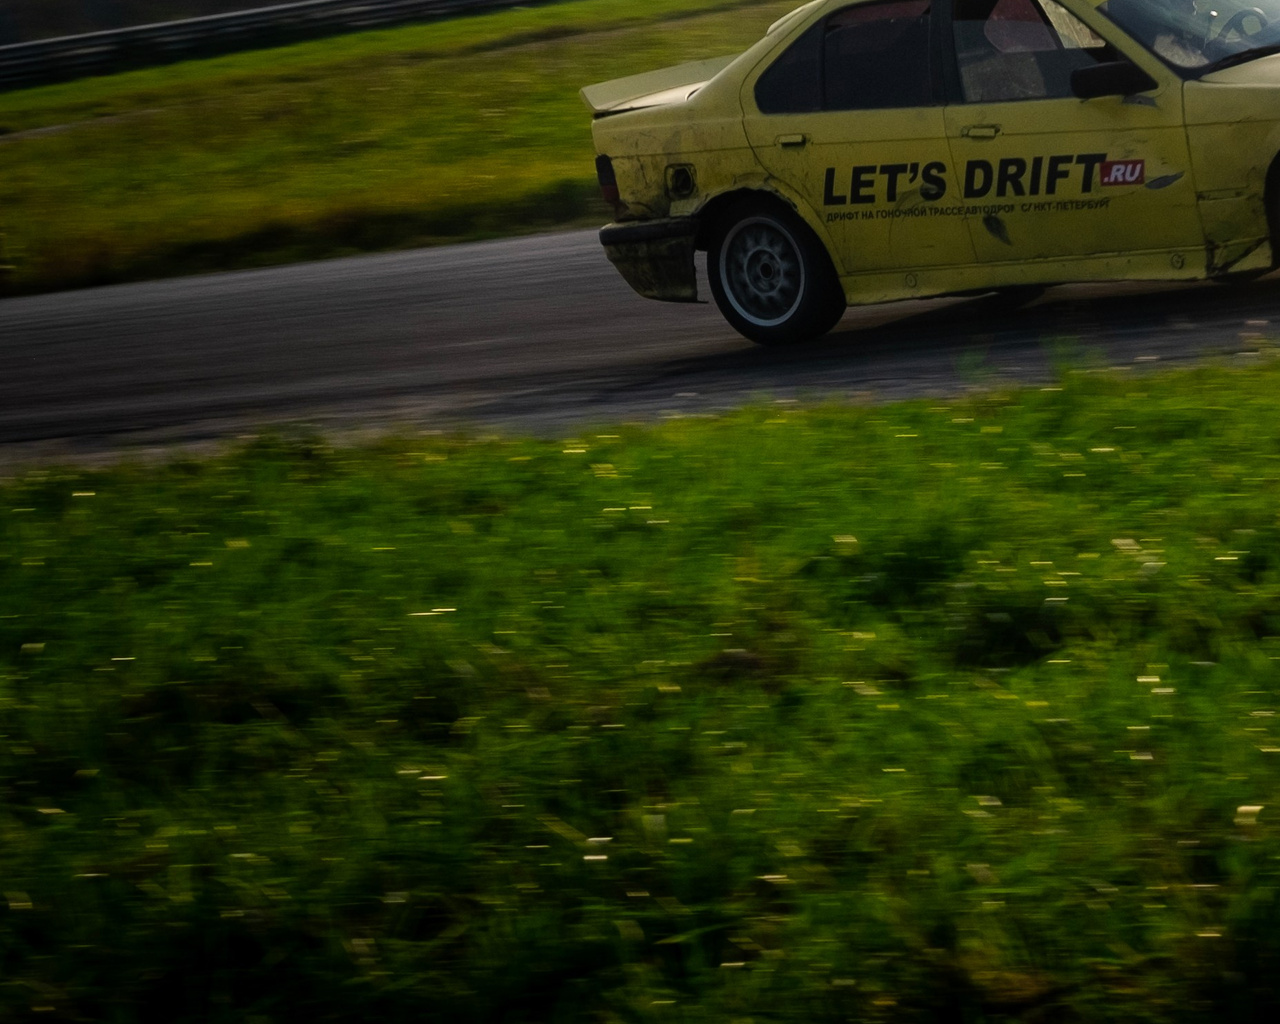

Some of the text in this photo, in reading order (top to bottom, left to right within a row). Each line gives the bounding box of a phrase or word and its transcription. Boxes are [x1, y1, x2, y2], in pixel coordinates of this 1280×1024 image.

[823, 153, 1141, 206] LET'S DRIFT .RU
[826, 211, 859, 223] ДРИФТ
[862, 210, 874, 220] НА
[928, 205, 963, 216] ТРАССЕ
